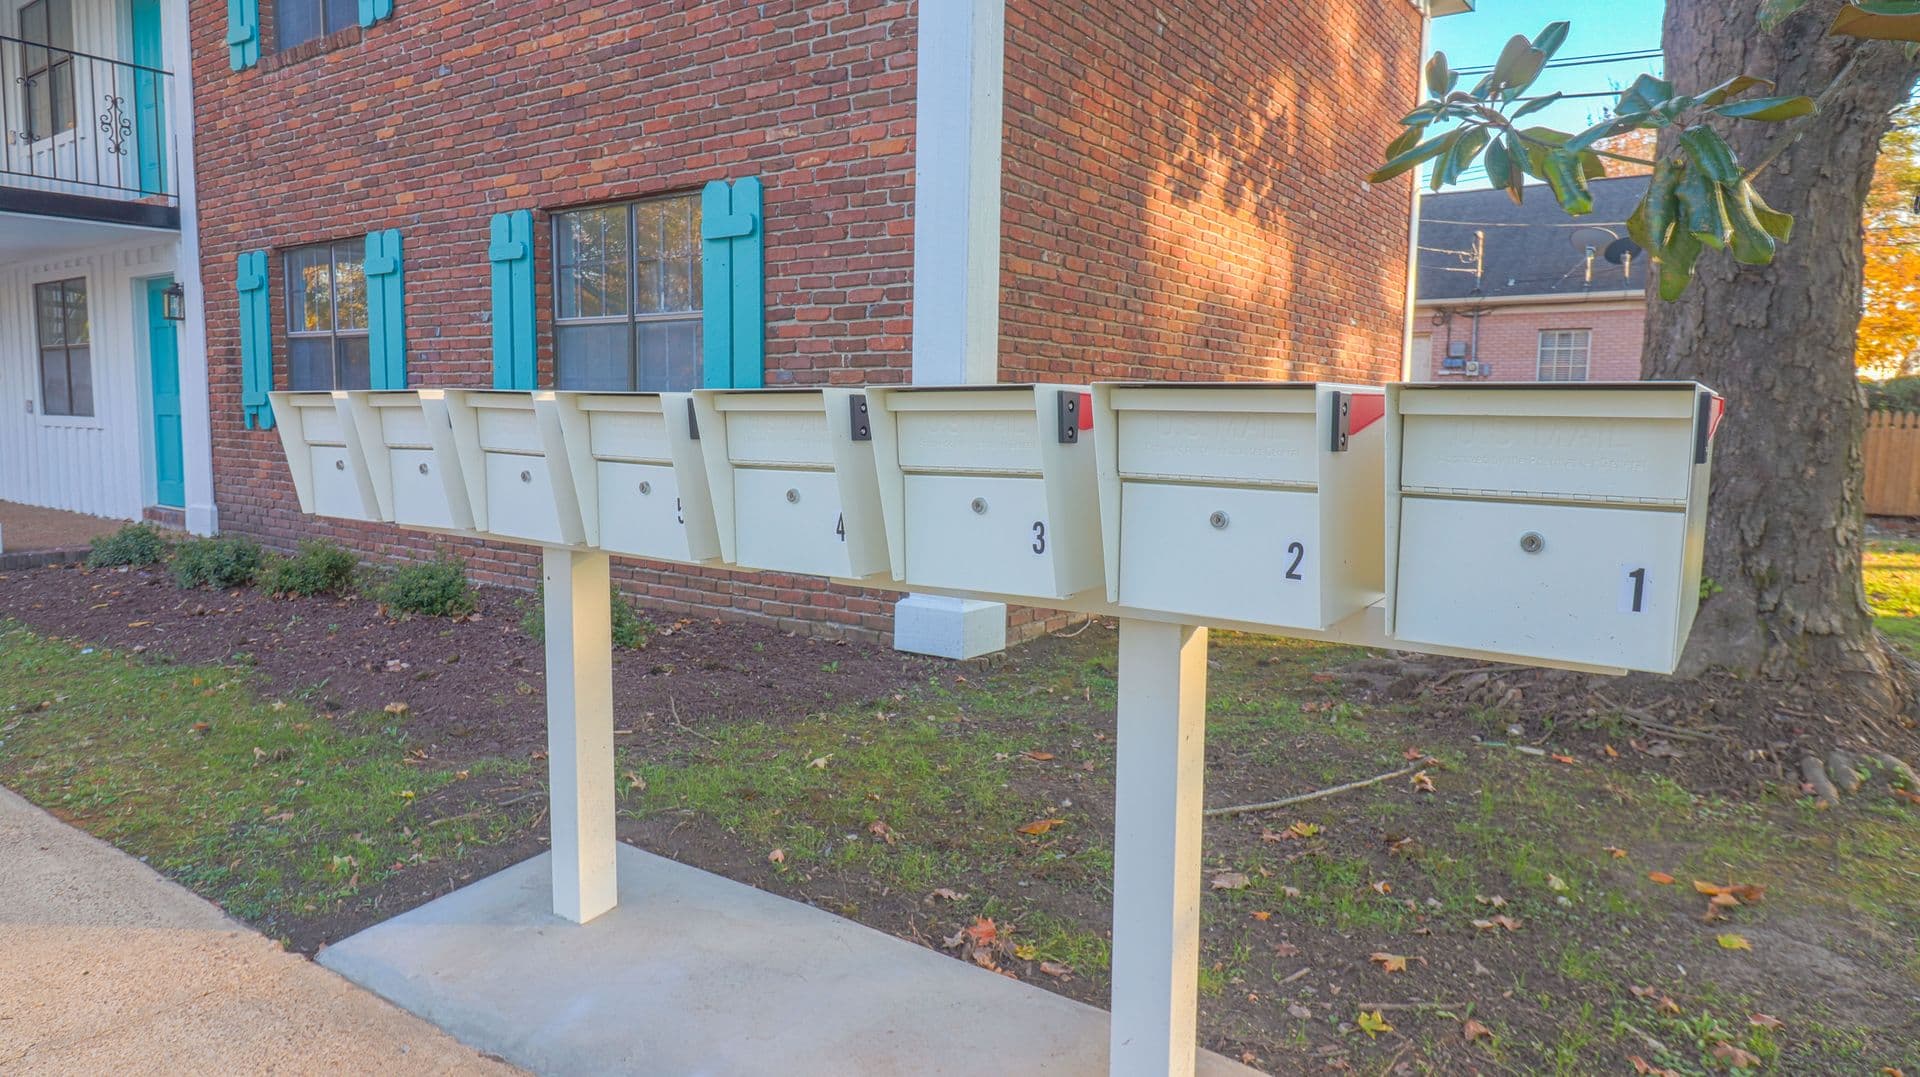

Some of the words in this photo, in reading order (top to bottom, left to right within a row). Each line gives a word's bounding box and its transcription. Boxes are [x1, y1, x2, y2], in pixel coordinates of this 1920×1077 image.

[836, 511, 845, 542] 4
[1032, 521, 1045, 554] 3
[1285, 541, 1305, 580] 2
[1628, 567, 1645, 612] 1
